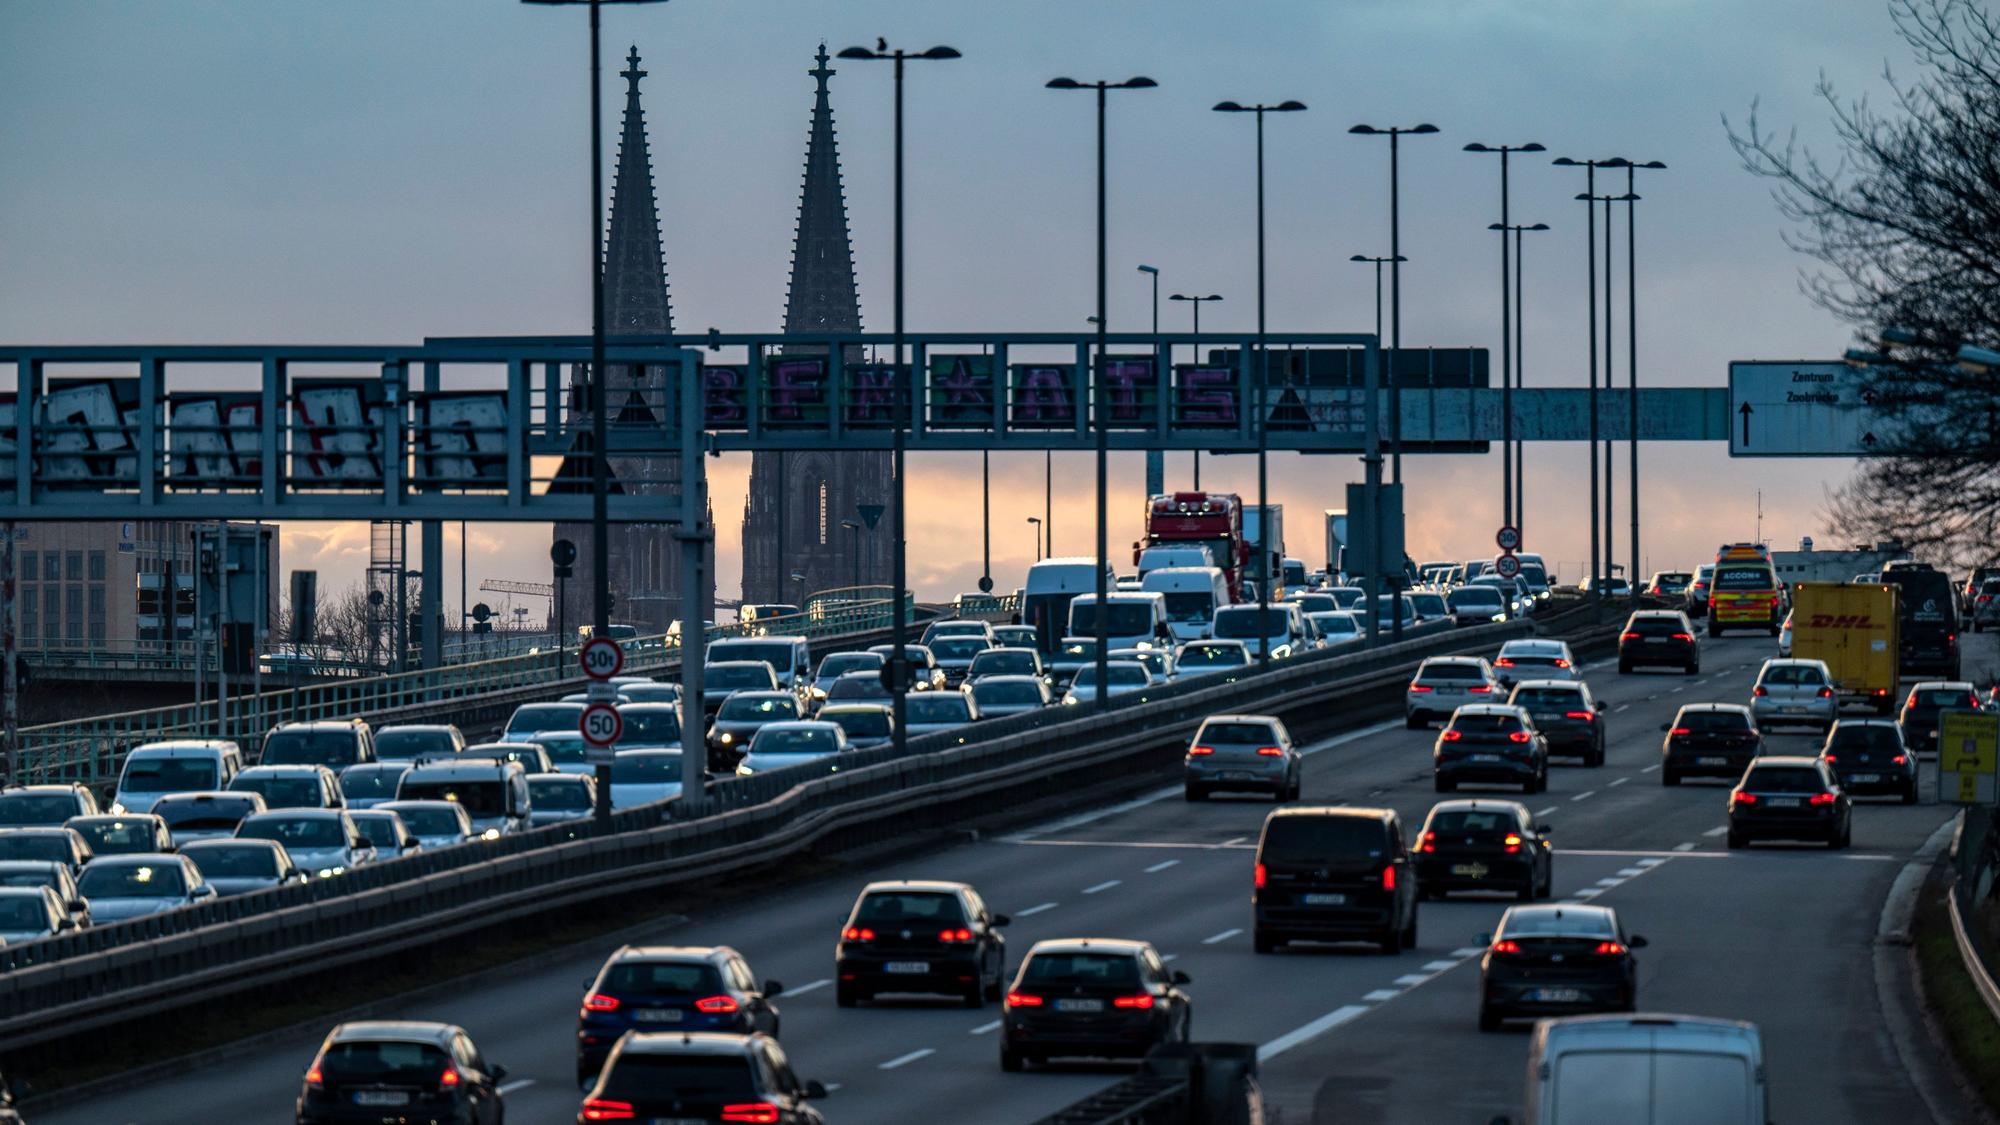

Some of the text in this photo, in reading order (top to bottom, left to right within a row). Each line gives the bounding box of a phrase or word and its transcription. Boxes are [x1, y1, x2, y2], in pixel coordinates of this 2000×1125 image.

[1792, 371, 1834, 383] Zentrum
[1810, 614, 1873, 629] DHL
[587, 649, 614, 668] 30t
[589, 714, 614, 735] 50
